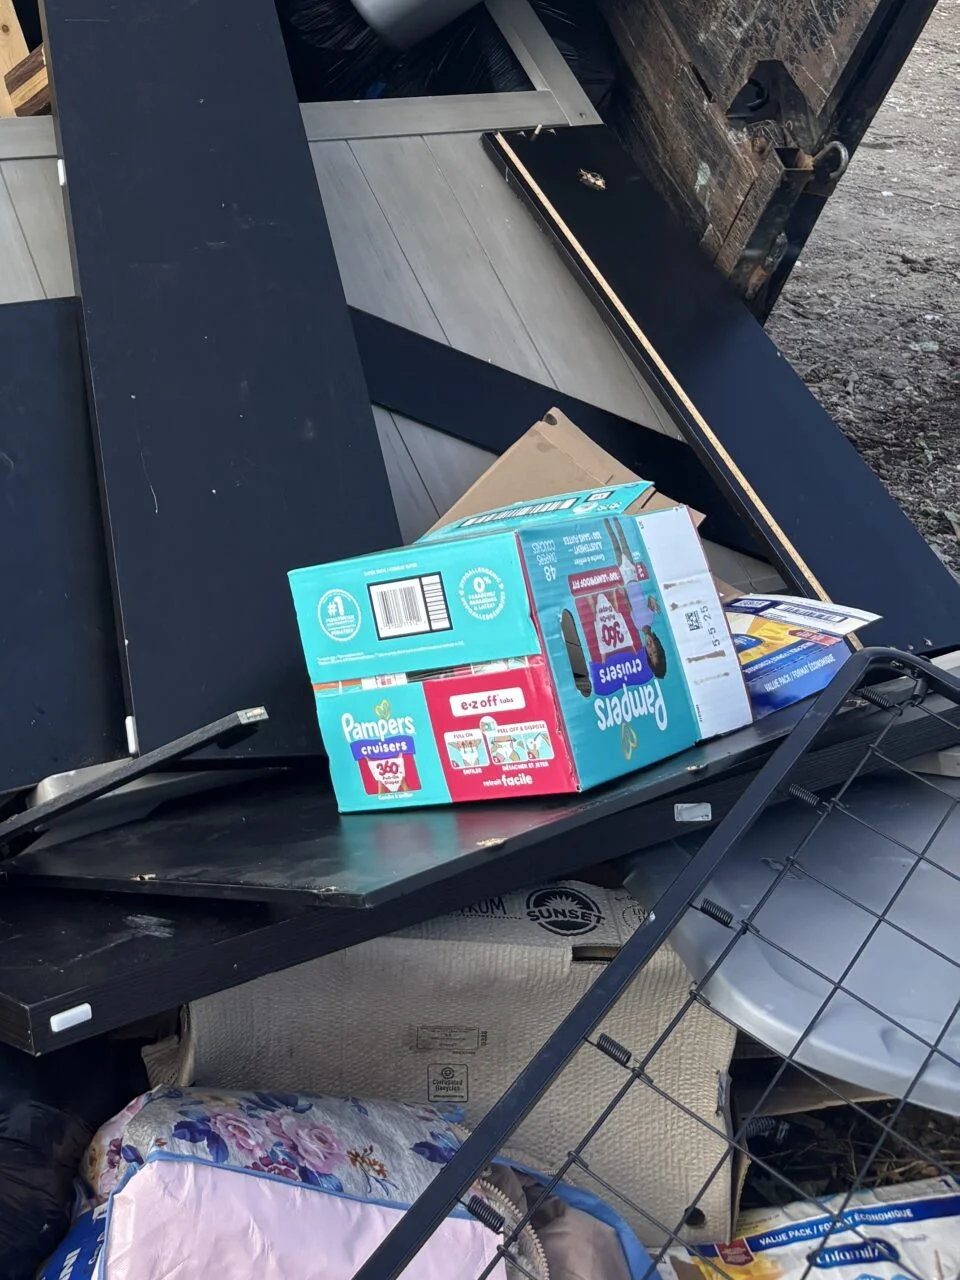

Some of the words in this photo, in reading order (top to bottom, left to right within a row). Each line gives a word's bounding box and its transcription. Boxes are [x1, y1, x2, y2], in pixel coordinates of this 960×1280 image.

[543, 565, 557, 582] 48
[326, 595, 345, 617] #1
[600, 657, 641, 684] cruisers
[763, 679, 780, 692] VALUE
[780, 673, 791, 687] PACK
[793, 664, 809, 679] FORMAT
[480, 695, 497, 708] off
[594, 677, 668, 732] Pampers
[341, 712, 416, 742] Pampers
[524, 723, 546, 731] DISPOSE
[361, 741, 408, 755] cruisers
[501, 773, 533, 787] facile
[526, 908, 605, 925] SUNSET
[759, 1232, 788, 1246] VALUE
[789, 1227, 812, 1242] PACK
[853, 1208, 914, 1222] ÉCONOMIQUE
